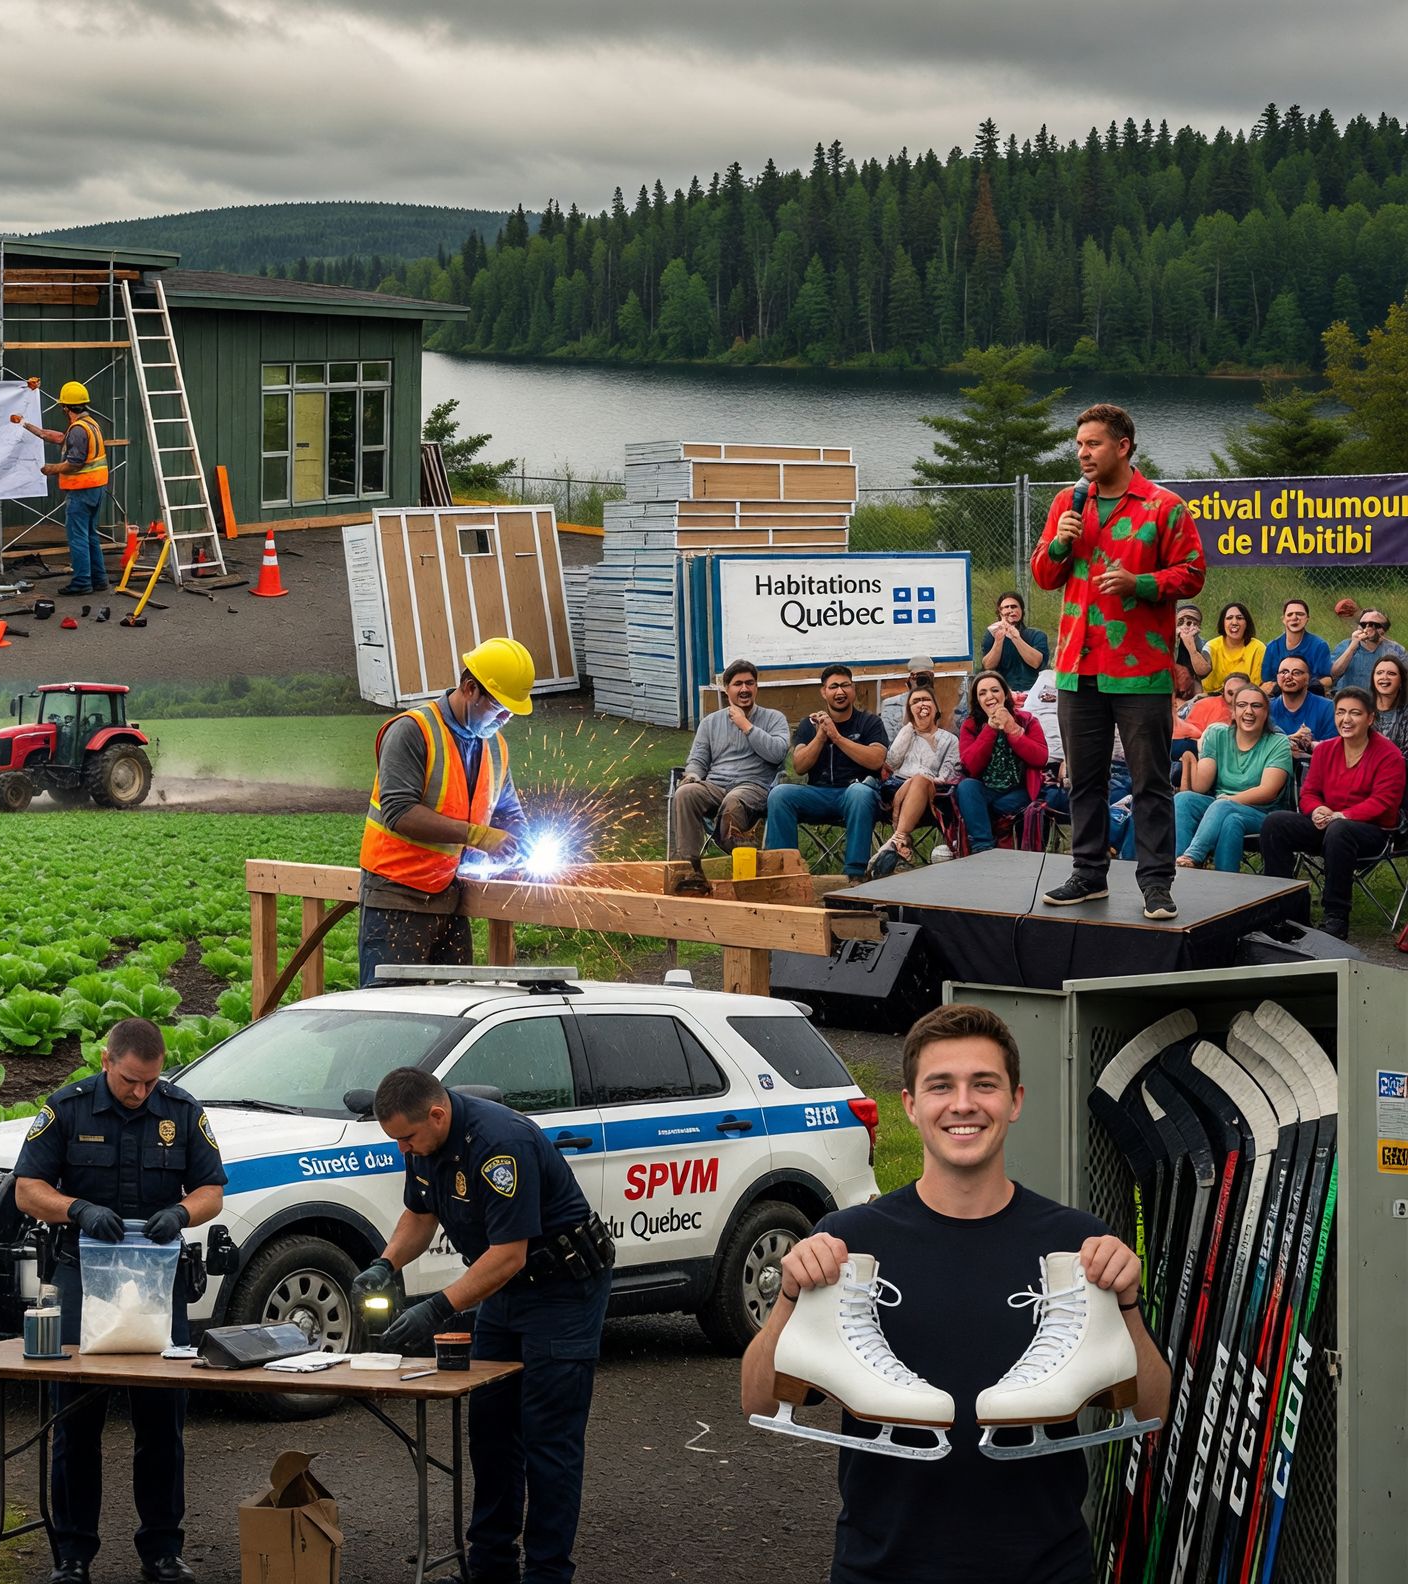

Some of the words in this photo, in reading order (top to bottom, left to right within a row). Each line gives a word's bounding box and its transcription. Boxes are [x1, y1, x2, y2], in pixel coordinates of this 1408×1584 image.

[1188, 490, 1261, 520] stival
[1217, 525, 1252, 555] de
[1261, 524, 1372, 554] l'Abitibi
[755, 574, 882, 596] Habitations
[780, 599, 885, 634] Québec
[624, 1157, 719, 1201] SPVM
